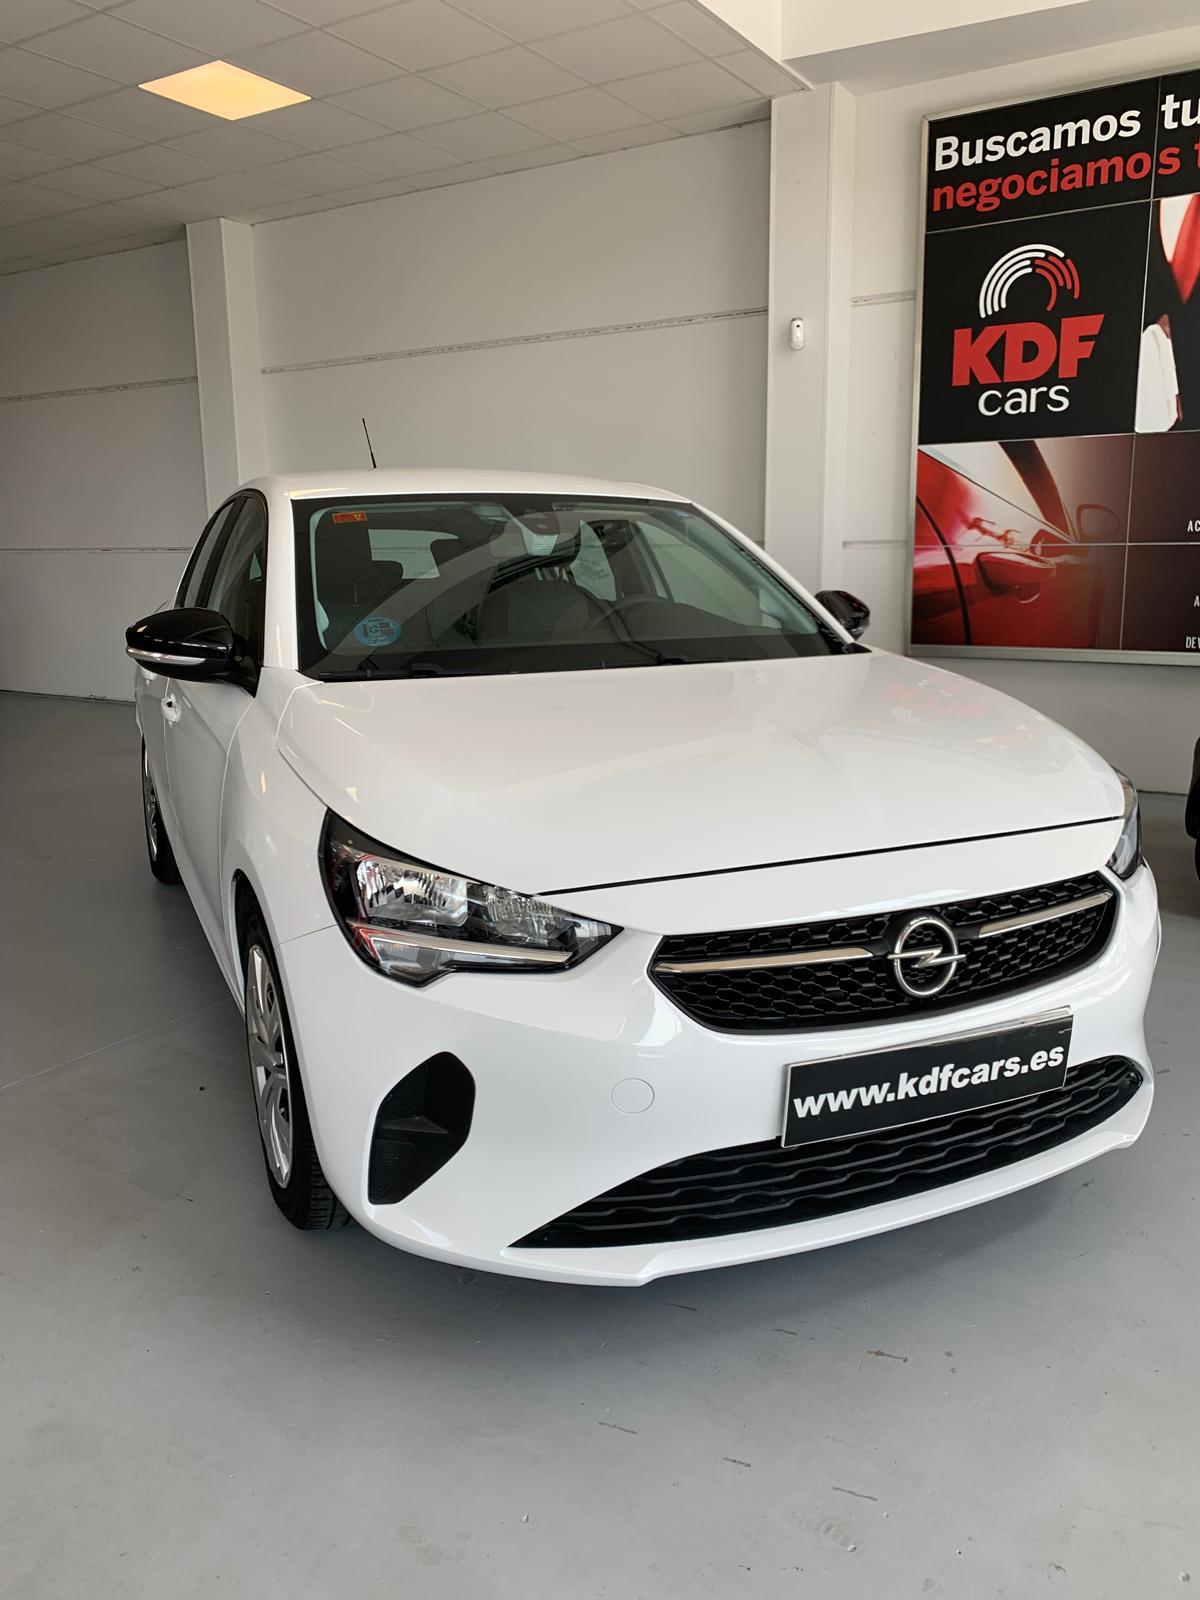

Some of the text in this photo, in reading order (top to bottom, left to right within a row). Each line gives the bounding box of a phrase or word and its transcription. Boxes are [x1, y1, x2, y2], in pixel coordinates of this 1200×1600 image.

[934, 110, 1141, 171] Buscamos
[1160, 93, 1200, 130] tu
[932, 146, 1181, 213] negociamos
[951, 314, 1105, 387] KDF
[978, 385, 1070, 417] cars
[793, 1045, 1064, 1118] www.kdfcars.es
